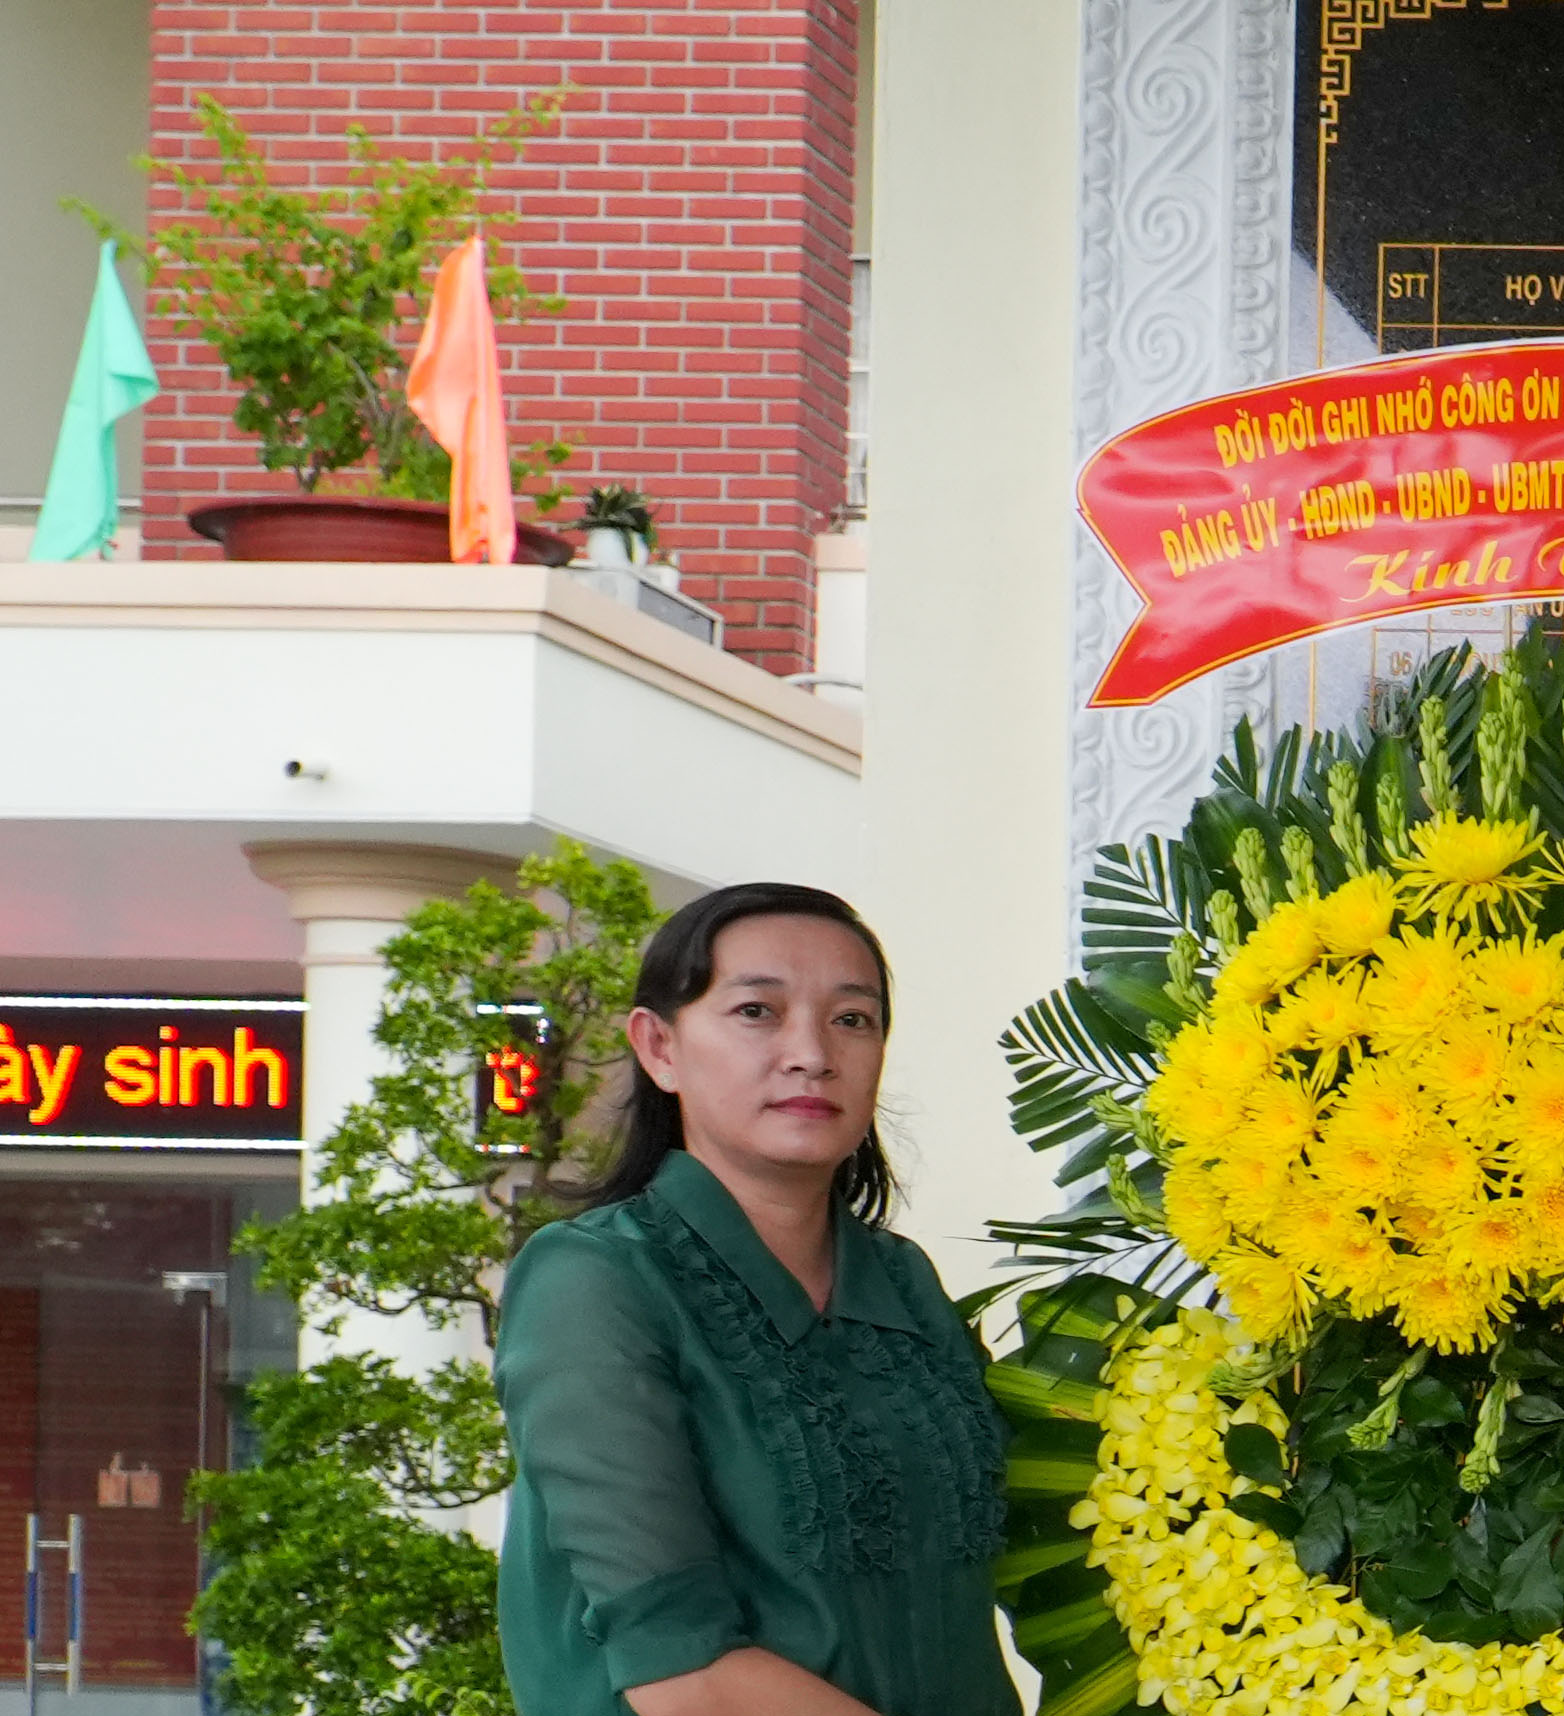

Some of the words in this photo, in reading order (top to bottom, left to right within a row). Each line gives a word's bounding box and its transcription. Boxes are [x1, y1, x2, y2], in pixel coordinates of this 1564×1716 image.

[1388, 272, 1429, 299] STT
[1505, 273, 1543, 306] HỌ
[1214, 409, 1266, 467] ĐỜI
[1268, 397, 1317, 454] ĐỜI
[1322, 397, 1370, 444] GHI
[1376, 379, 1433, 435] NHỚ
[1441, 373, 1514, 428] CÔNG
[1522, 368, 1559, 421] ƠN
[1161, 504, 1240, 577] ĐẢNG
[1242, 483, 1277, 551] ỦY
[1301, 481, 1376, 539] HĐND
[1397, 467, 1471, 522] UBND
[1340, 541, 1517, 604] Kính
[104, 1024, 288, 1109] sinh
